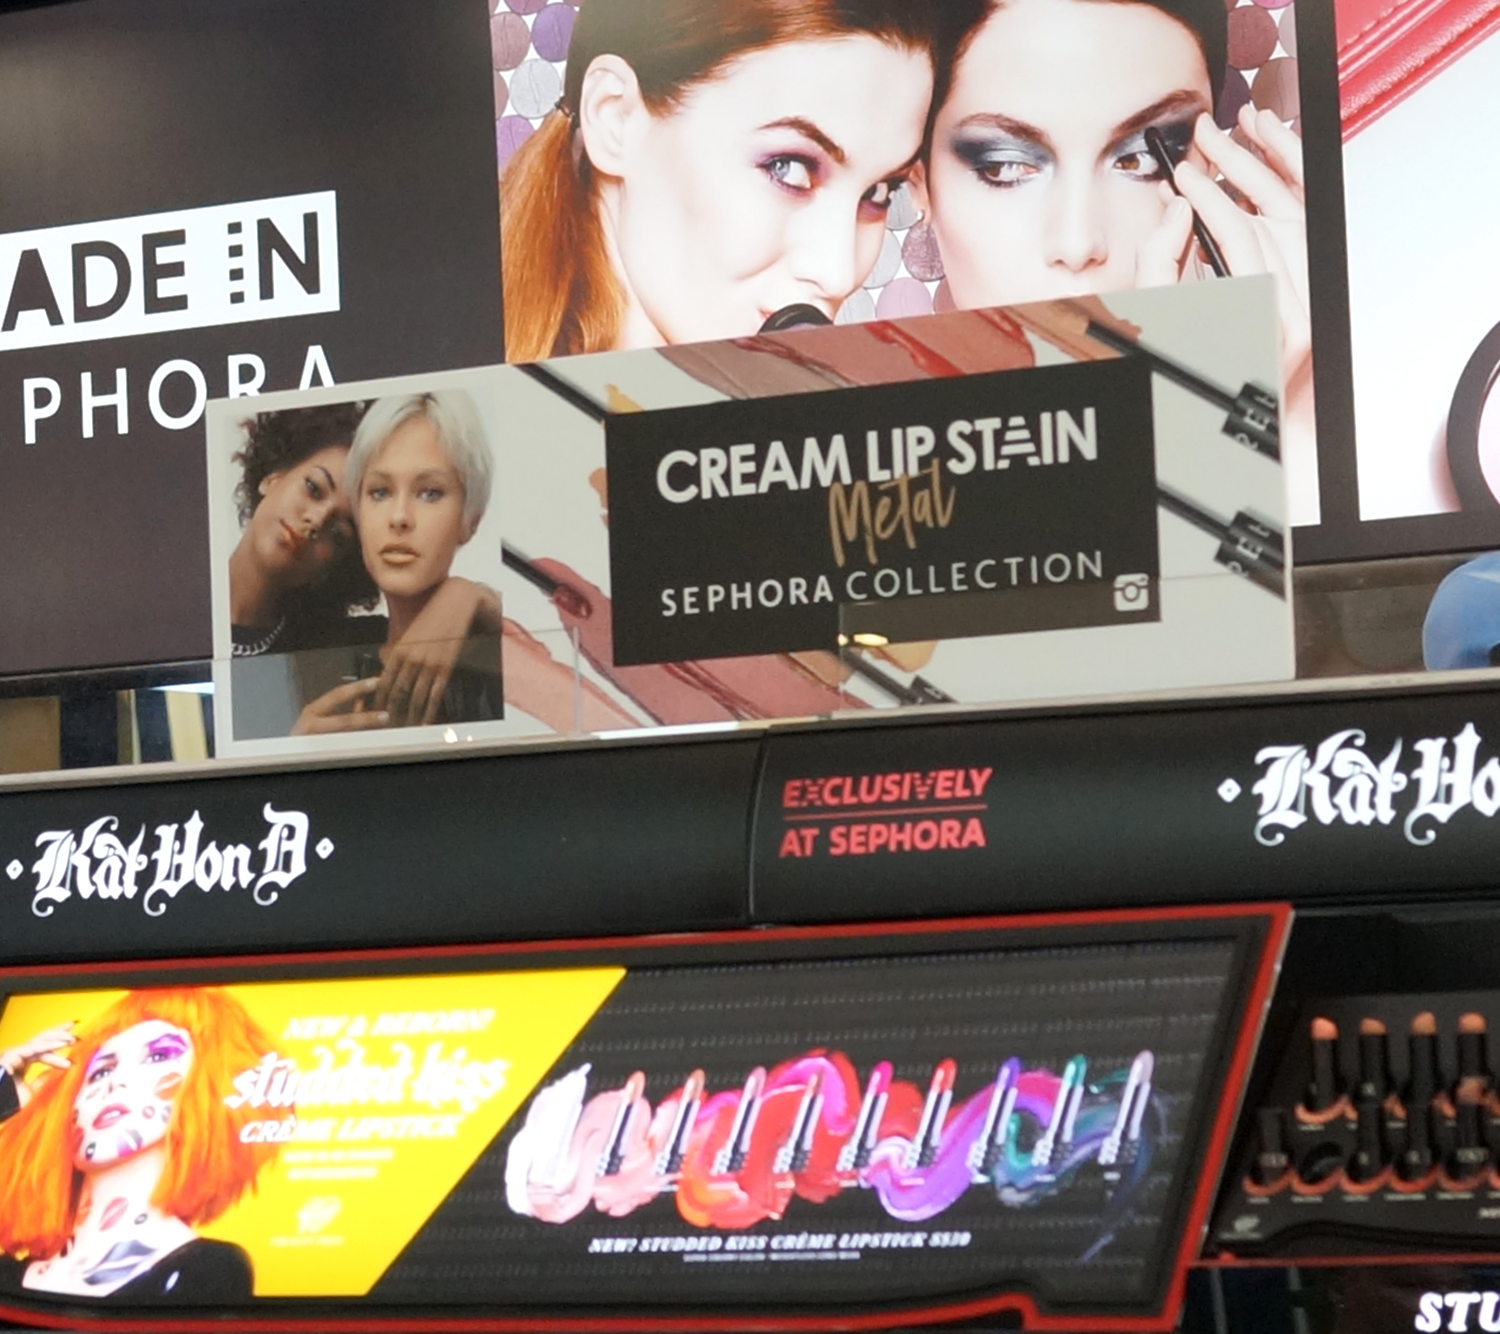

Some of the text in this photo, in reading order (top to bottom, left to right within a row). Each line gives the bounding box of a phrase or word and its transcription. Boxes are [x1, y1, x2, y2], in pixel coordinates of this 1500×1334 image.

[226, 211, 322, 306] IN
[656, 407, 1098, 503] CREAM LIP STAIN
[828, 458, 956, 567] Metal
[661, 550, 1102, 617] SEPHORA COLLECTION
[782, 766, 993, 809] EXCLUSIVELY
[779, 818, 986, 859] AT SEPHORA
[282, 1015, 344, 1041] NEW
[337, 1113, 467, 1142] LIPSTICK
[639, 1236, 723, 1253] STUDDED
[725, 1235, 768, 1251] KISS
[838, 1232, 928, 1250] LIPSTICK
